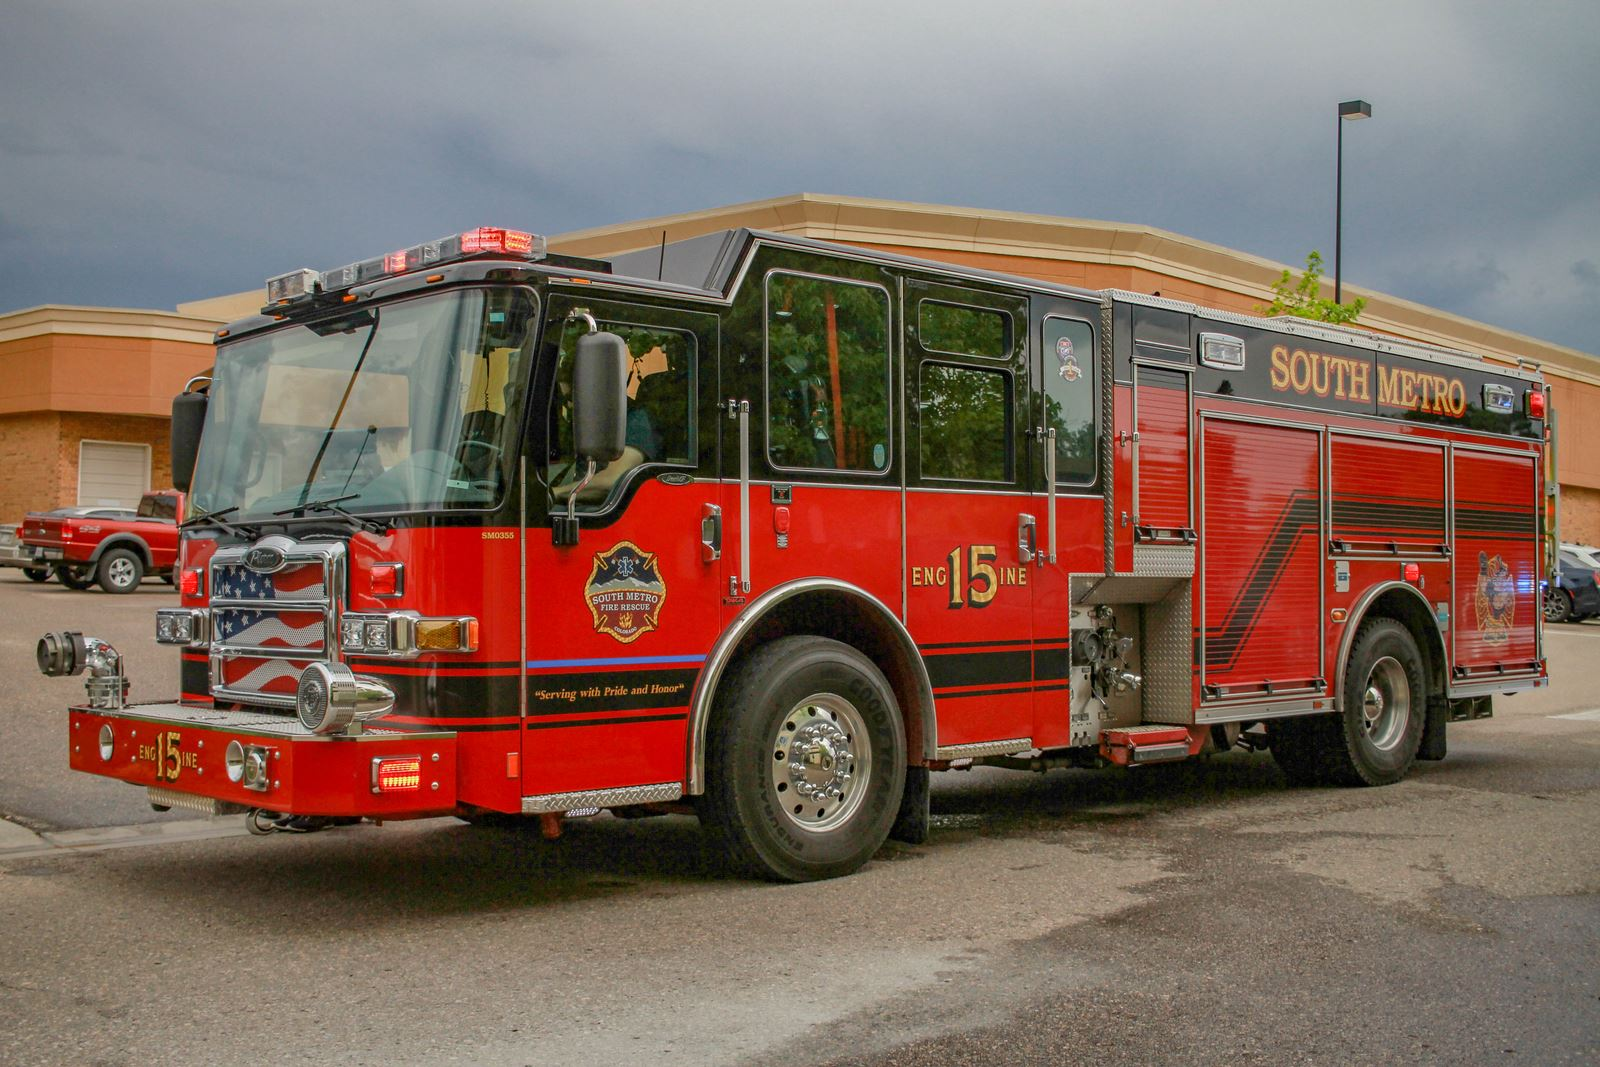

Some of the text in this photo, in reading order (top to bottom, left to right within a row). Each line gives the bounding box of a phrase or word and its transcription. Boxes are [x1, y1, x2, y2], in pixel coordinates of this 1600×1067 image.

[1270, 345, 1466, 418] SOUTH METRO
[481, 531, 514, 540] SM0355
[911, 544, 1027, 609] ENG 15 INE
[592, 592, 659, 605] SOUTH METRO
[620, 603, 650, 611] RESCUE
[613, 625, 638, 635] COLORADO
[580, 687, 601, 697] with
[604, 685, 628, 696] Pride
[630, 684, 648, 695] and
[139, 731, 198, 783] ENG 15 INE
